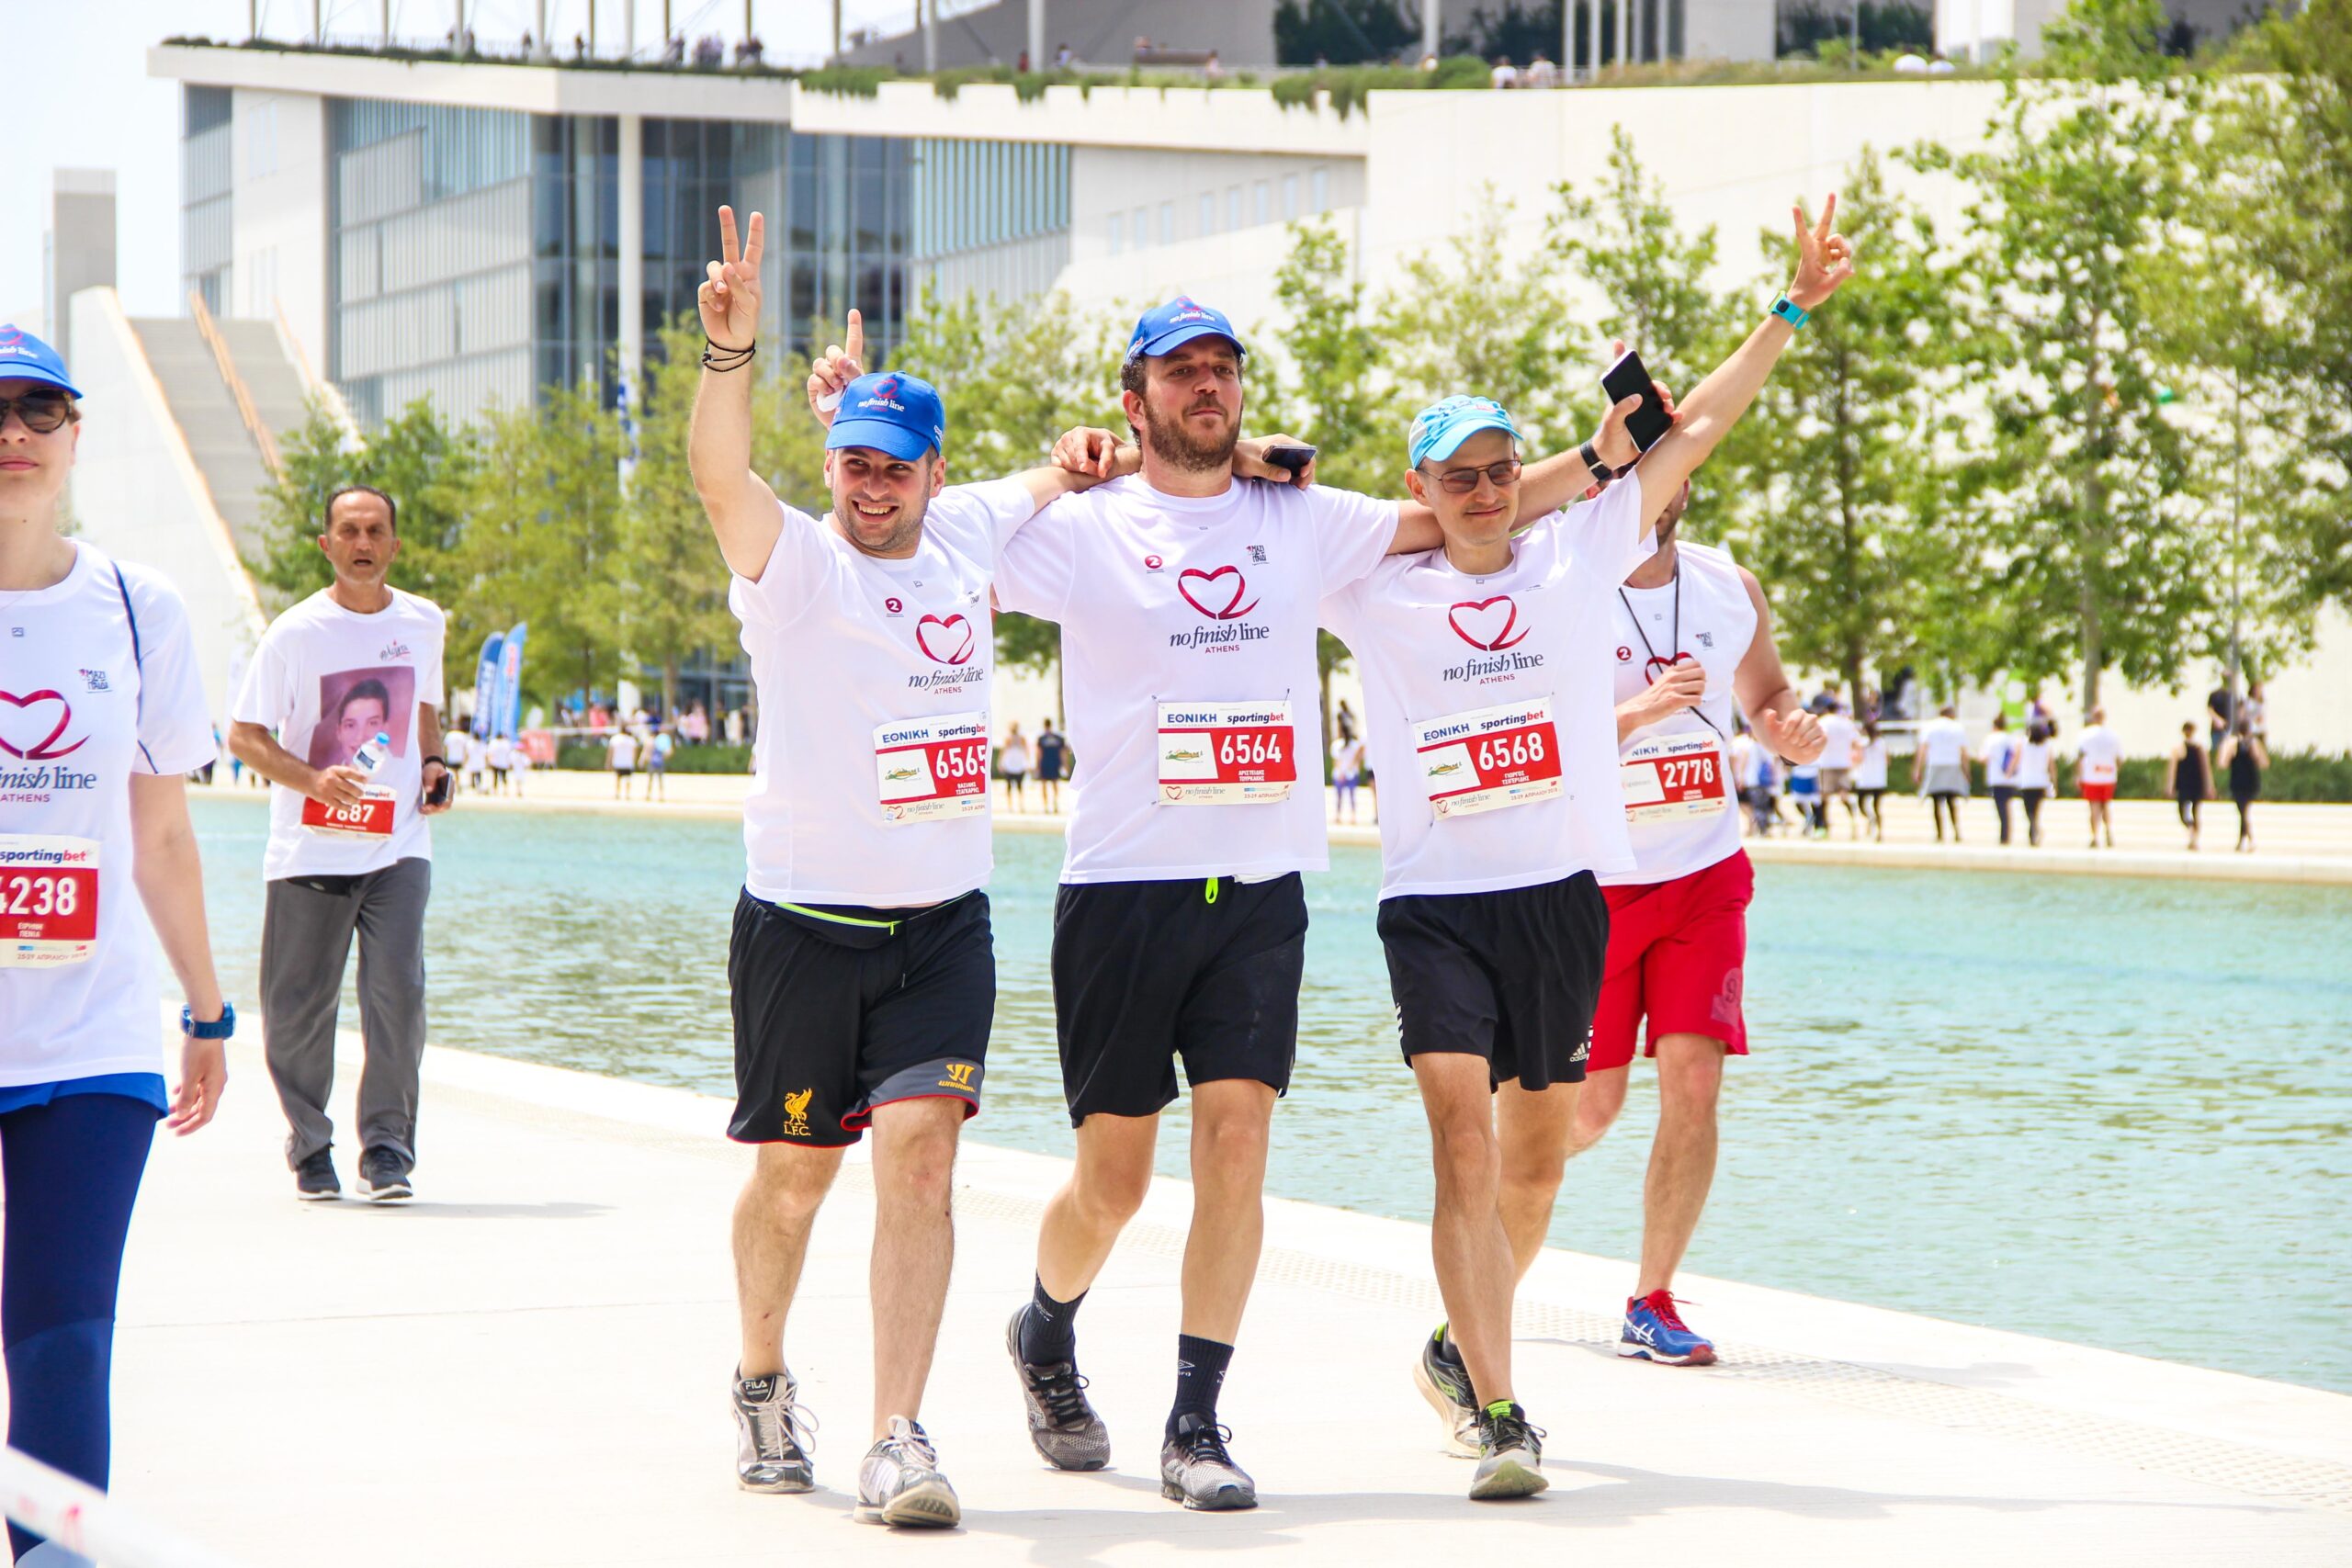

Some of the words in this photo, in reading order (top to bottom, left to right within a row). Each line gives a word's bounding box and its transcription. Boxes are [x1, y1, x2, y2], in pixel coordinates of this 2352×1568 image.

[889, 399, 905, 412] line
[1170, 632, 1192, 647] no
[1190, 624, 1238, 649] finish
[1238, 623, 1270, 640] line
[1204, 644, 1240, 653] ATHENS
[1442, 666, 1464, 682] no
[1463, 653, 1510, 682] finish
[1510, 652, 1544, 671] line
[908, 675, 929, 688] no
[924, 668, 965, 692] finish
[964, 666, 984, 682] line
[1479, 673, 1516, 685] ATHENS
[933, 686, 963, 695] ATHENS
[1167, 713, 1217, 724] ΕΘΝΙΚΗ
[1227, 712, 1285, 725] sportingbet
[1480, 710, 1544, 730] sportingbet
[882, 729, 930, 744] ΕΘΝΙΚΗ
[1424, 723, 1470, 742] ΕΘΝΙΚΗ
[1220, 733, 1283, 765] 6564
[1478, 732, 1545, 771] 6568
[1668, 740, 1713, 753] sportingbet
[52, 766, 97, 789] line
[1663, 758, 1714, 788] 2778
[1, 793, 51, 803] ATHENS
[0, 849, 86, 864] sportingbet
[745, 1380, 768, 1390] FILA
